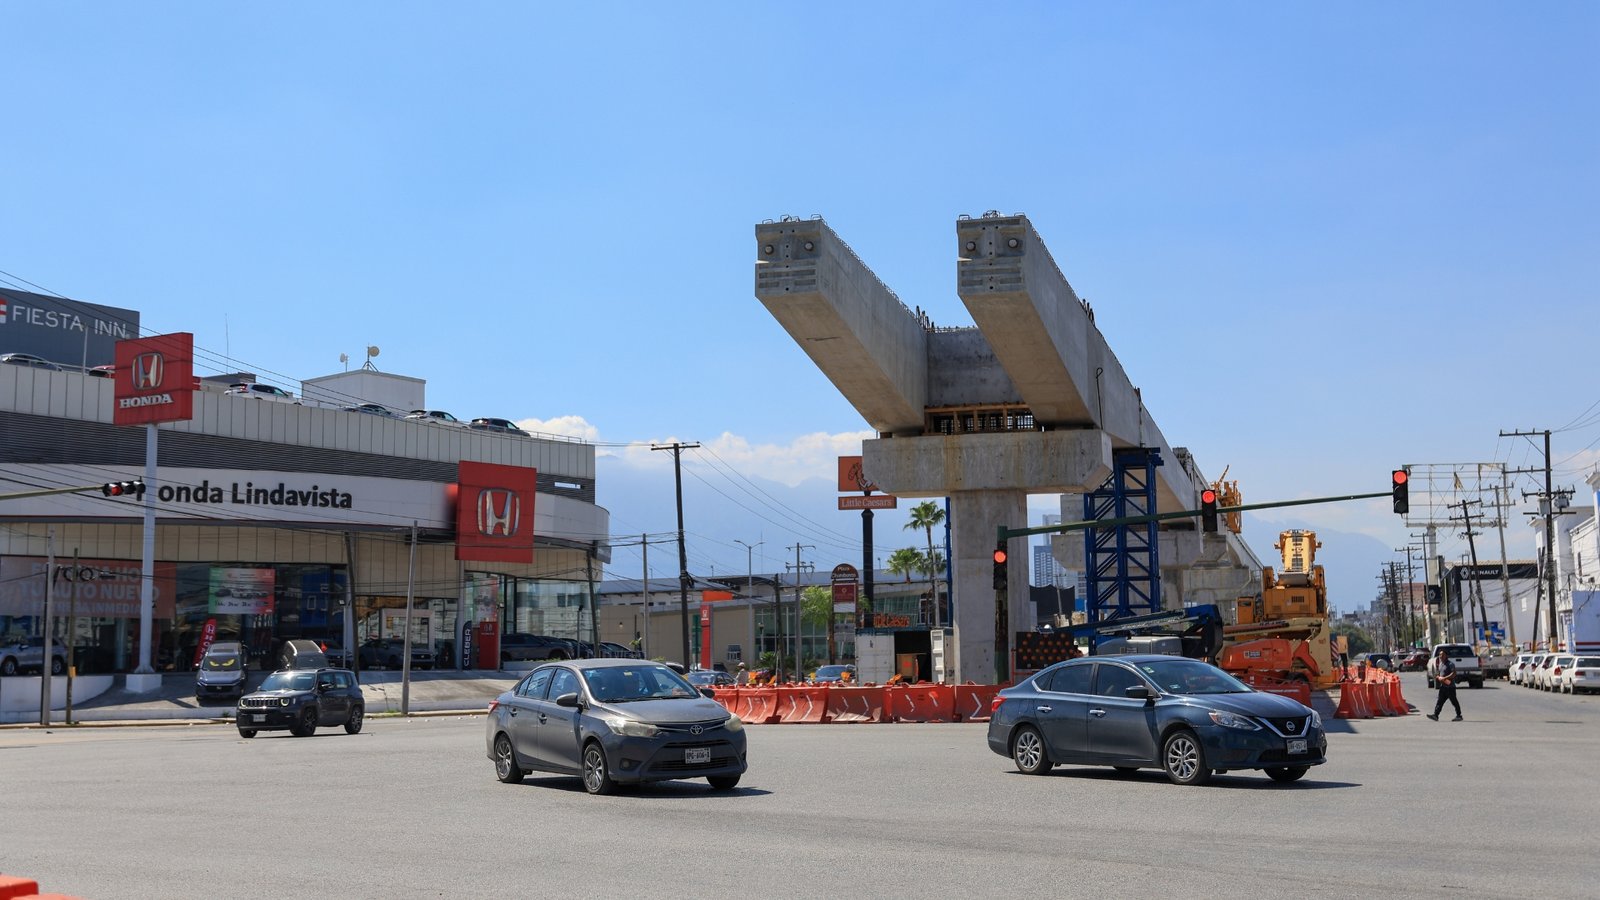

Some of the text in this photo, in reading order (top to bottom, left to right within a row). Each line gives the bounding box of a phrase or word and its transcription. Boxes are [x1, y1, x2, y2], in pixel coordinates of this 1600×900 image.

[12, 305, 127, 338] FIESTA INN
[119, 393, 174, 409] HONDA
[231, 481, 353, 509] Lindavista
[841, 498, 893, 508] Little Caesars
[53, 583, 98, 599] AUTO
[100, 584, 161, 601] NUEO
[463, 628, 472, 667] CLEBER
